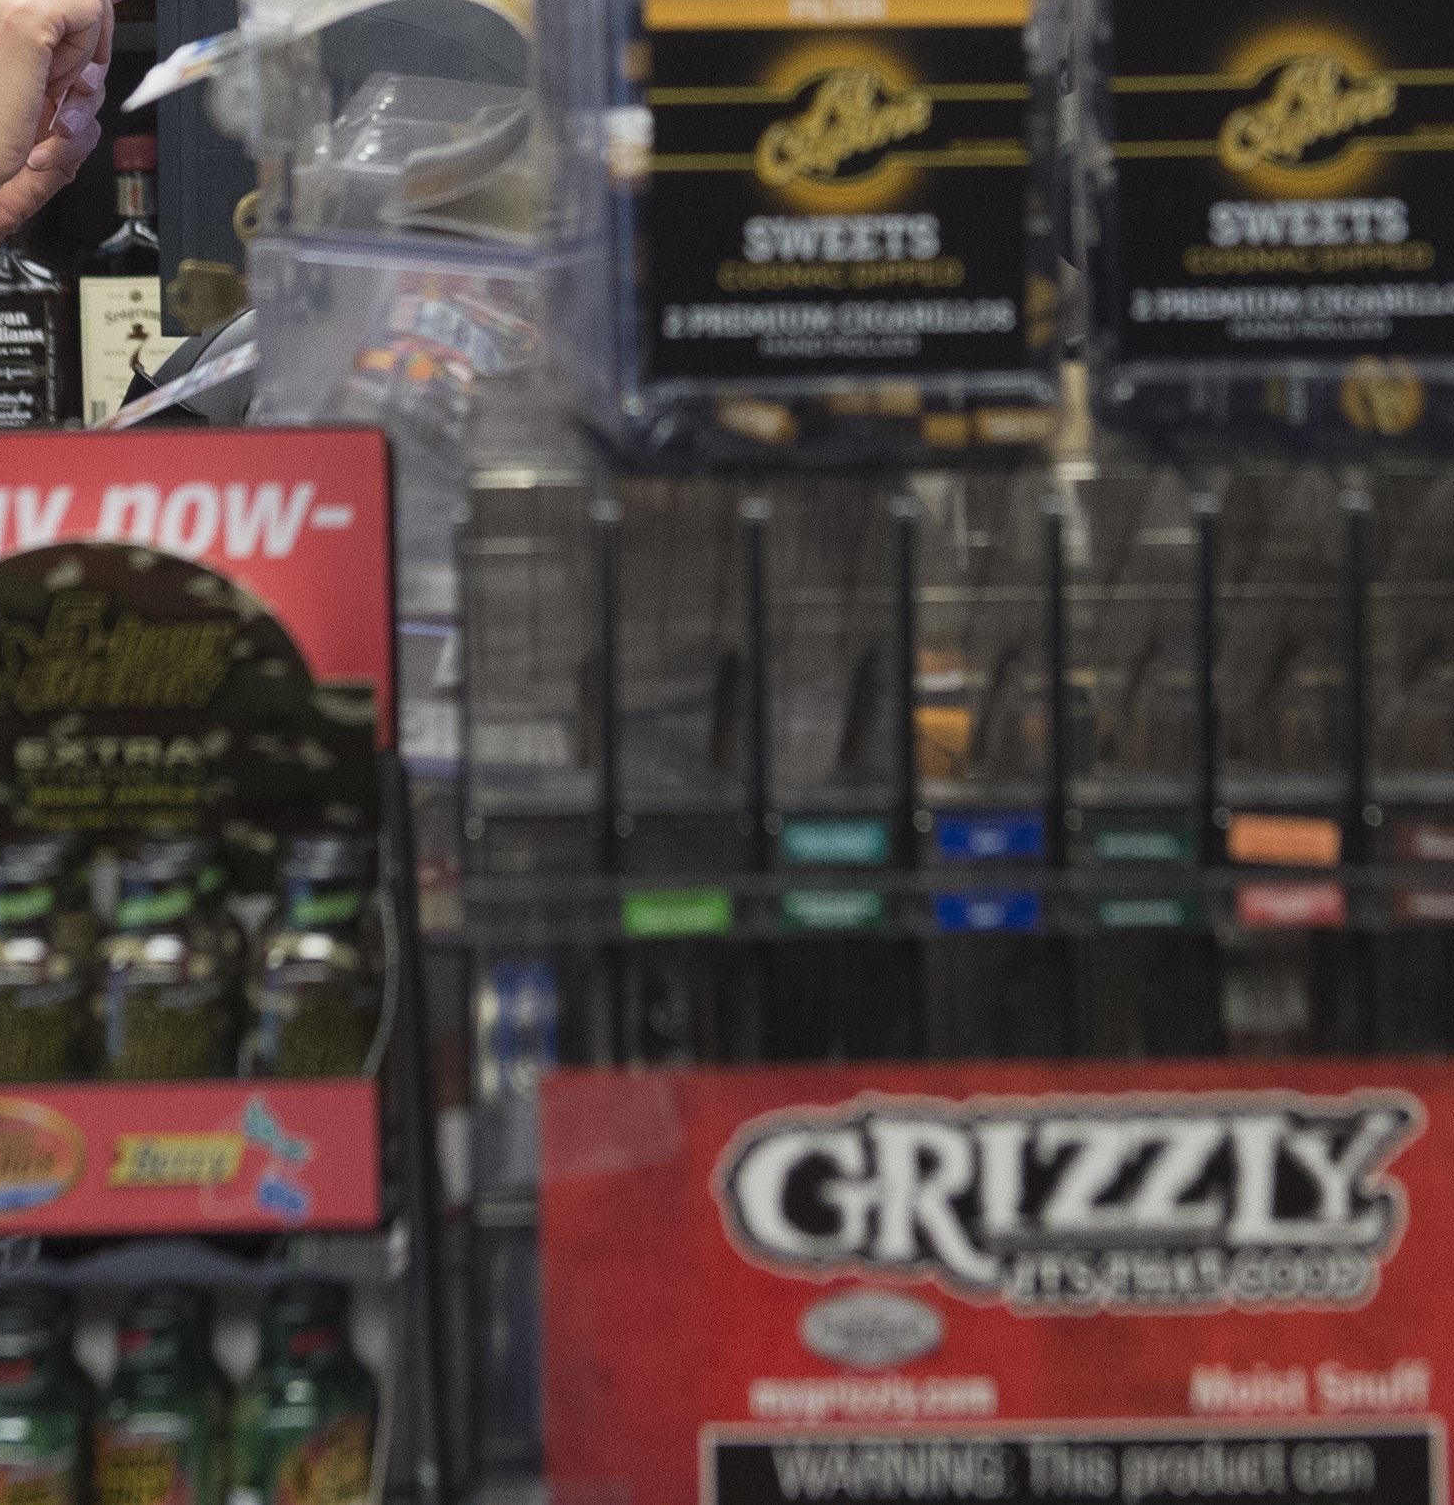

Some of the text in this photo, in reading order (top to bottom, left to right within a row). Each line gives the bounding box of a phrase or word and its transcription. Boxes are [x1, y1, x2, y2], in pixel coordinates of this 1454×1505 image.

[743, 213, 941, 263] SWEETS
[1207, 198, 1409, 247] SWEETS
[104, 307, 161, 325] Seagram
[735, 1105, 1411, 1283] GRIZZLY
[1188, 1357, 1432, 1416] Moist Snuff
[1025, 1439, 1117, 1497] This
[1120, 1437, 1285, 1504] product
[1291, 1443, 1377, 1493] can
